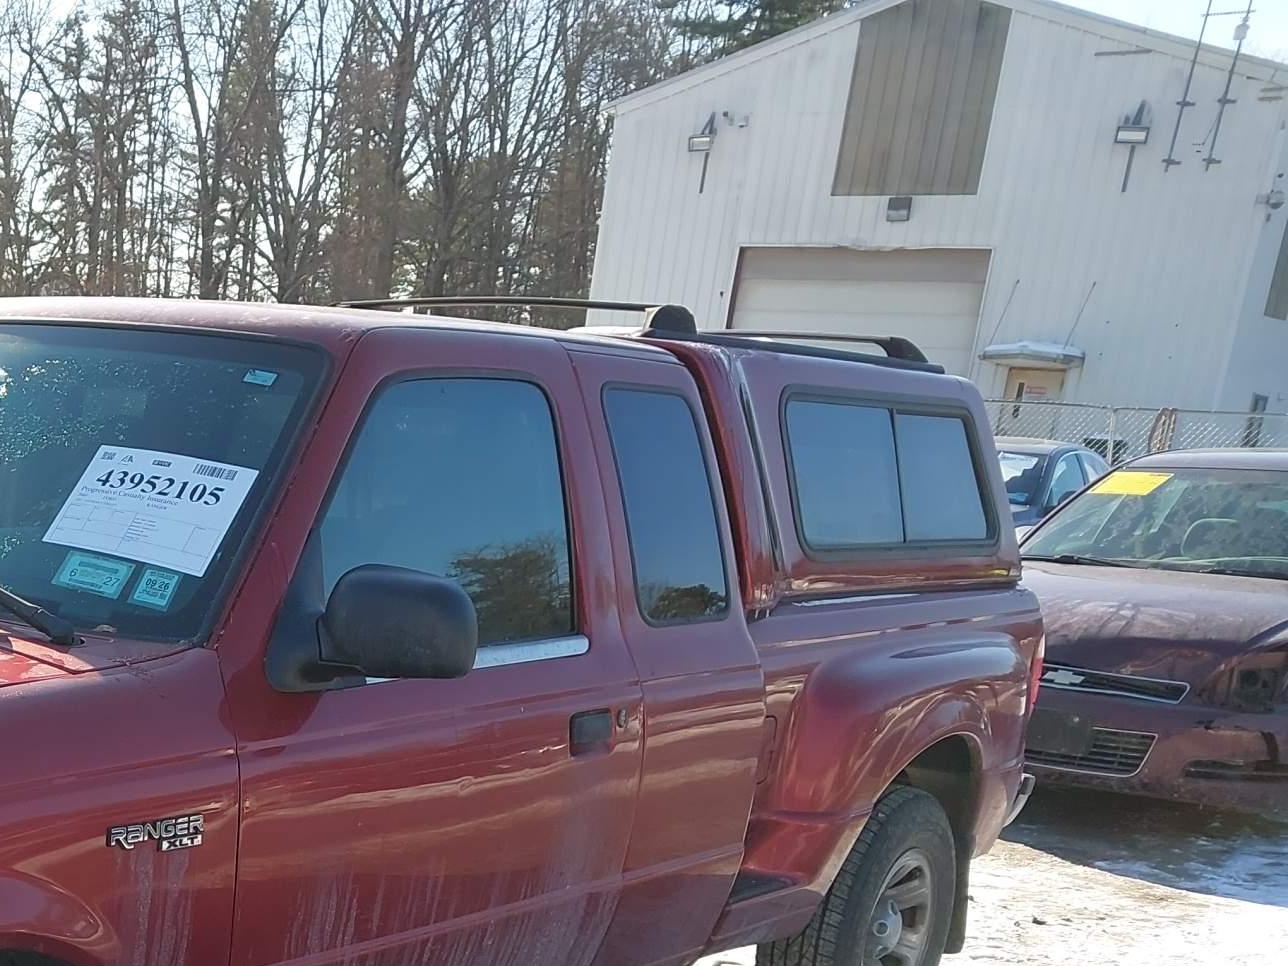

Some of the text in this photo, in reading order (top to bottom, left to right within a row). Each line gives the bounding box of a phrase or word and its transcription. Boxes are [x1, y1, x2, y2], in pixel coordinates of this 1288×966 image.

[95, 468, 226, 506] 43952105
[146, 495, 179, 506] Insurance
[69, 568, 78, 577] 6
[103, 576, 120, 587] 27
[110, 814, 204, 848] RANGER
[166, 836, 198, 849] XLT
